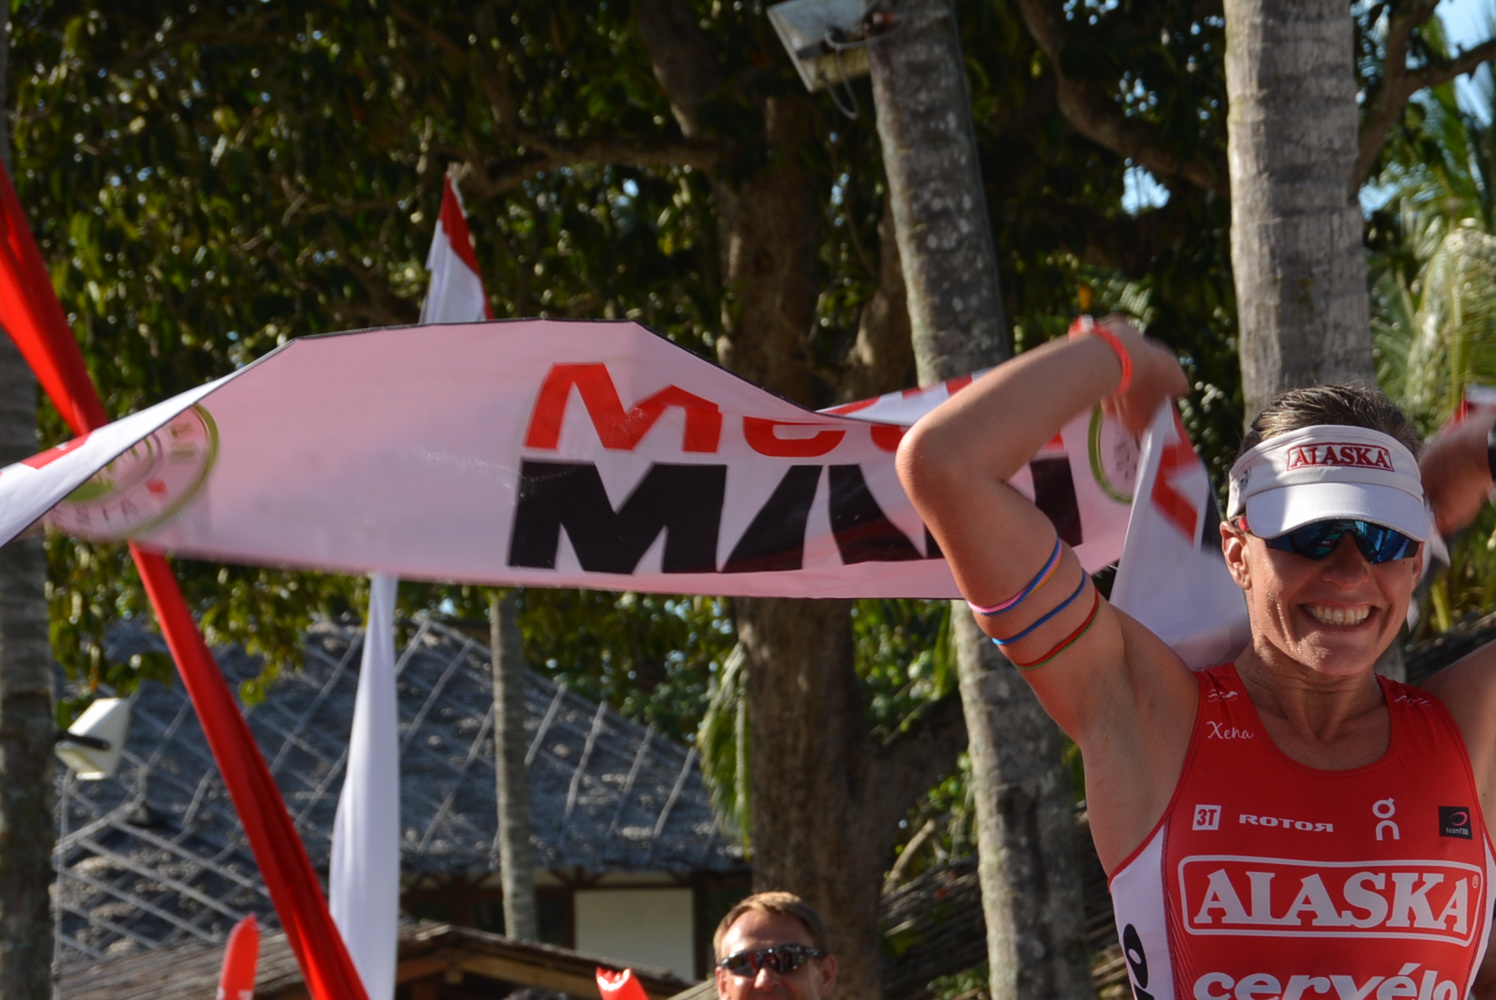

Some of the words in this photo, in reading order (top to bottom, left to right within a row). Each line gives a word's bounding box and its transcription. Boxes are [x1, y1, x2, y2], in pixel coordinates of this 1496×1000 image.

[524, 362, 908, 458] Me
[1290, 445, 1391, 468] ALASKA
[1207, 721, 1255, 740] Xena
[1196, 807, 1218, 828] 3T
[1193, 868, 1469, 935] ALASKA
